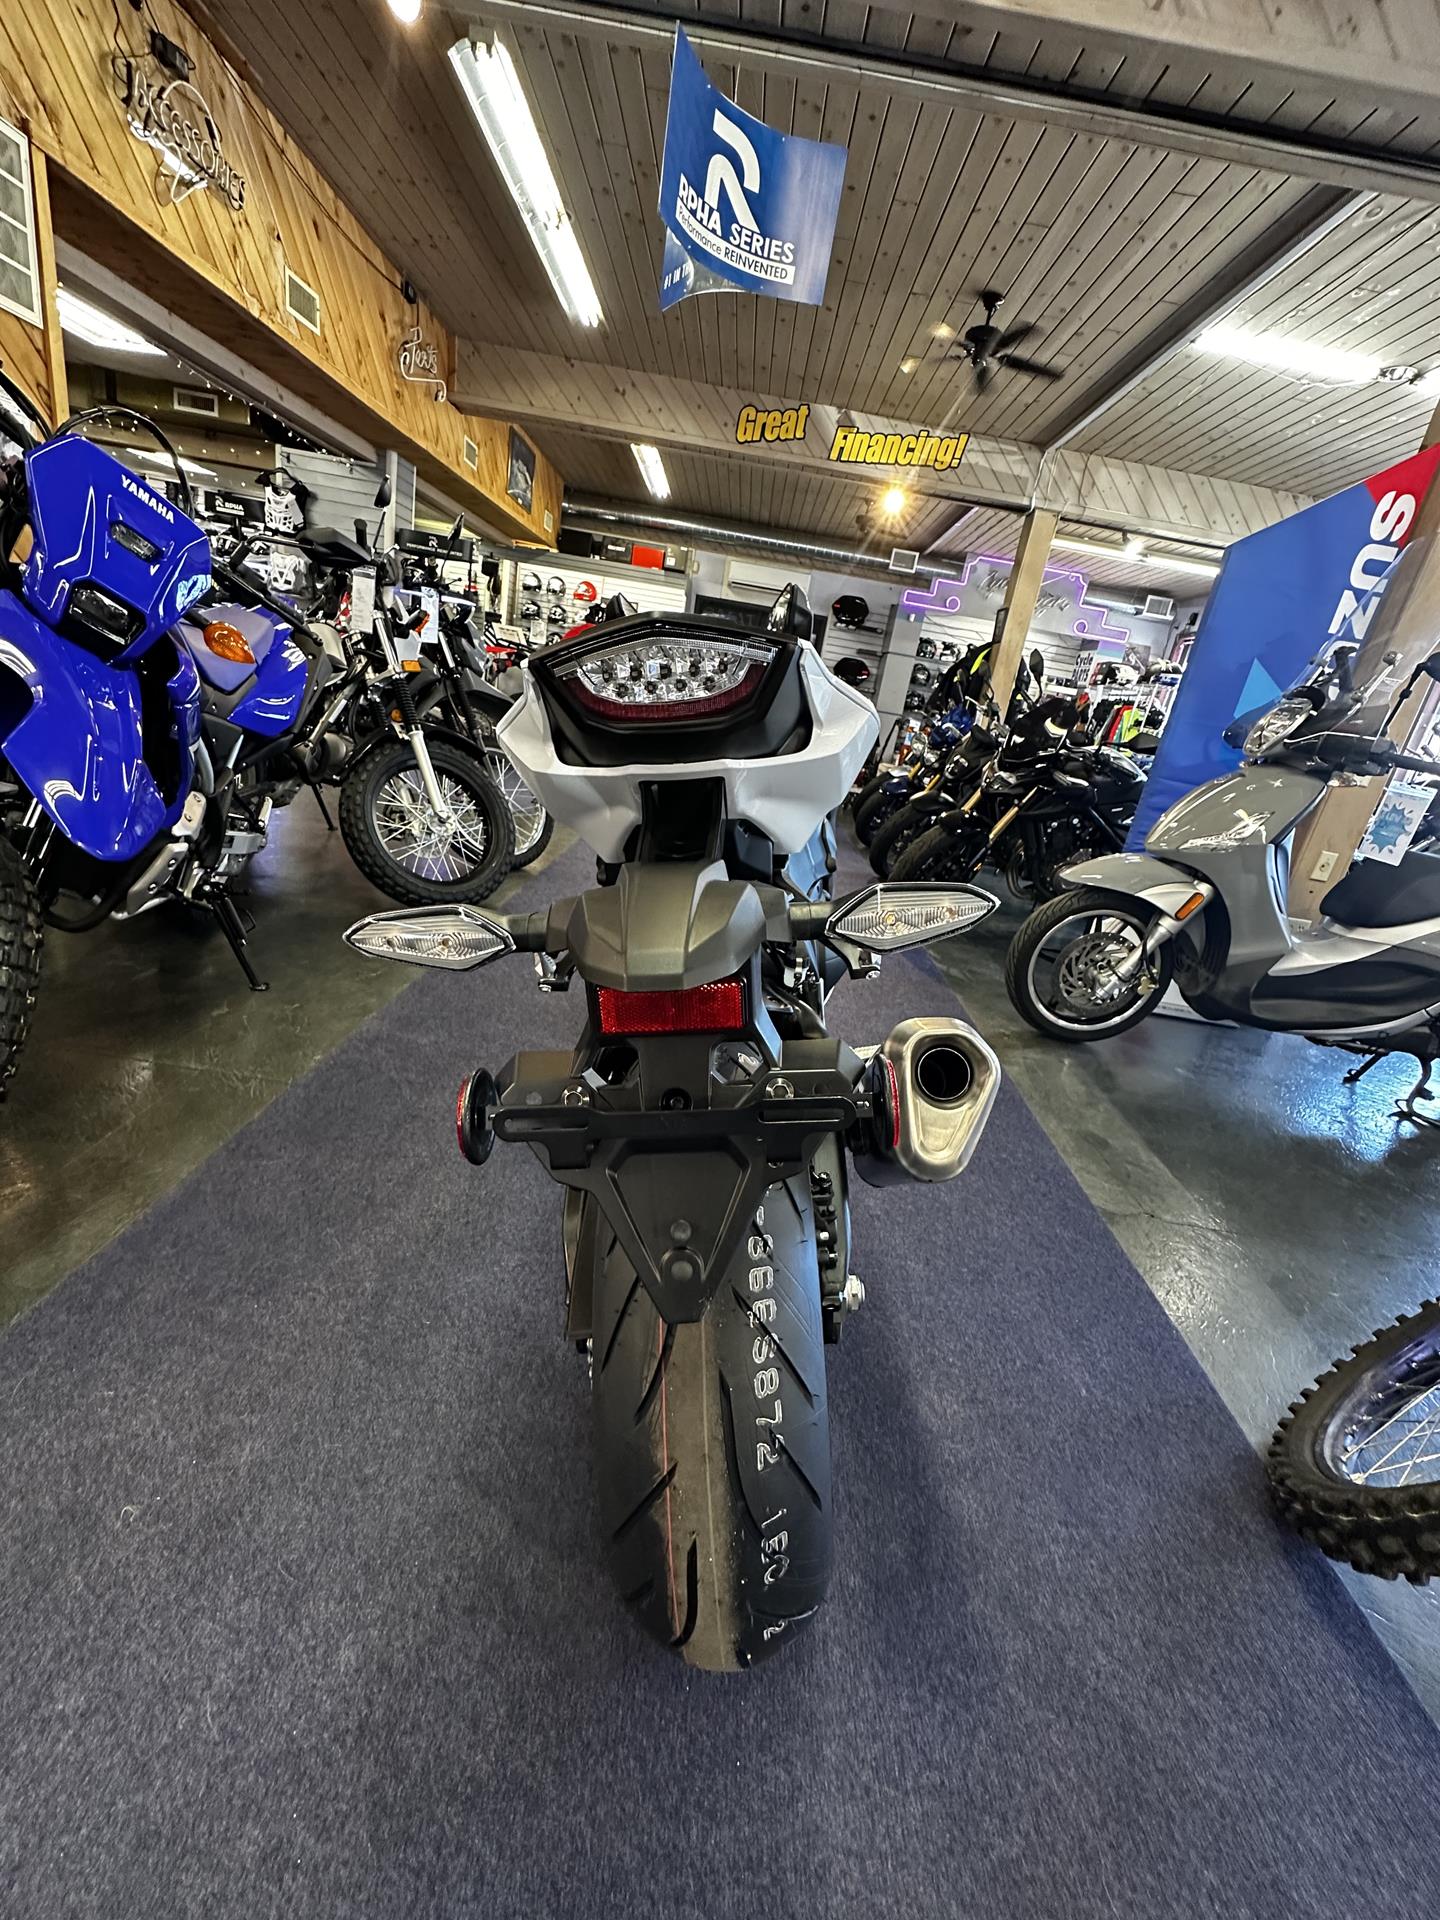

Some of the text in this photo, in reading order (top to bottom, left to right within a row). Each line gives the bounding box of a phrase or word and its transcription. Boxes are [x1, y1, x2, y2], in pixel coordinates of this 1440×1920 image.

[678, 206, 788, 280] Performance REINVENTED
[679, 173, 795, 264] RPHA SERIES
[736, 404, 970, 470] Great Financing!
[121, 473, 174, 524] YAMAHA
